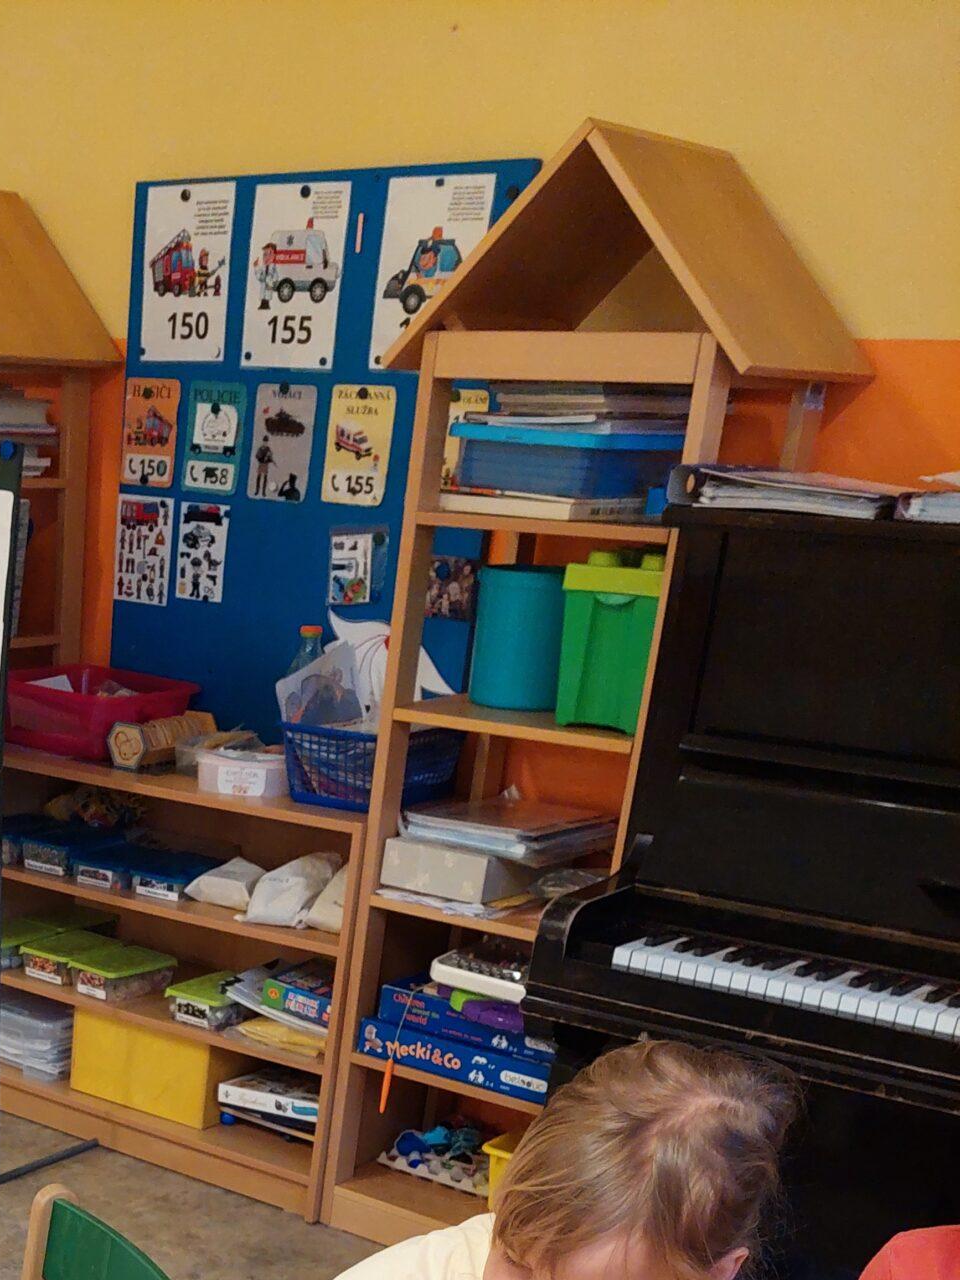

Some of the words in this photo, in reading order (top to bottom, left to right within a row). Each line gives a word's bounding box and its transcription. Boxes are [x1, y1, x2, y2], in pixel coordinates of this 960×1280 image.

[167, 311, 209, 340] 150
[267, 315, 313, 344] 155
[139, 458, 167, 477] 150
[345, 474, 374, 494] 155
[385, 1041, 462, 1070] Mecki&Co
